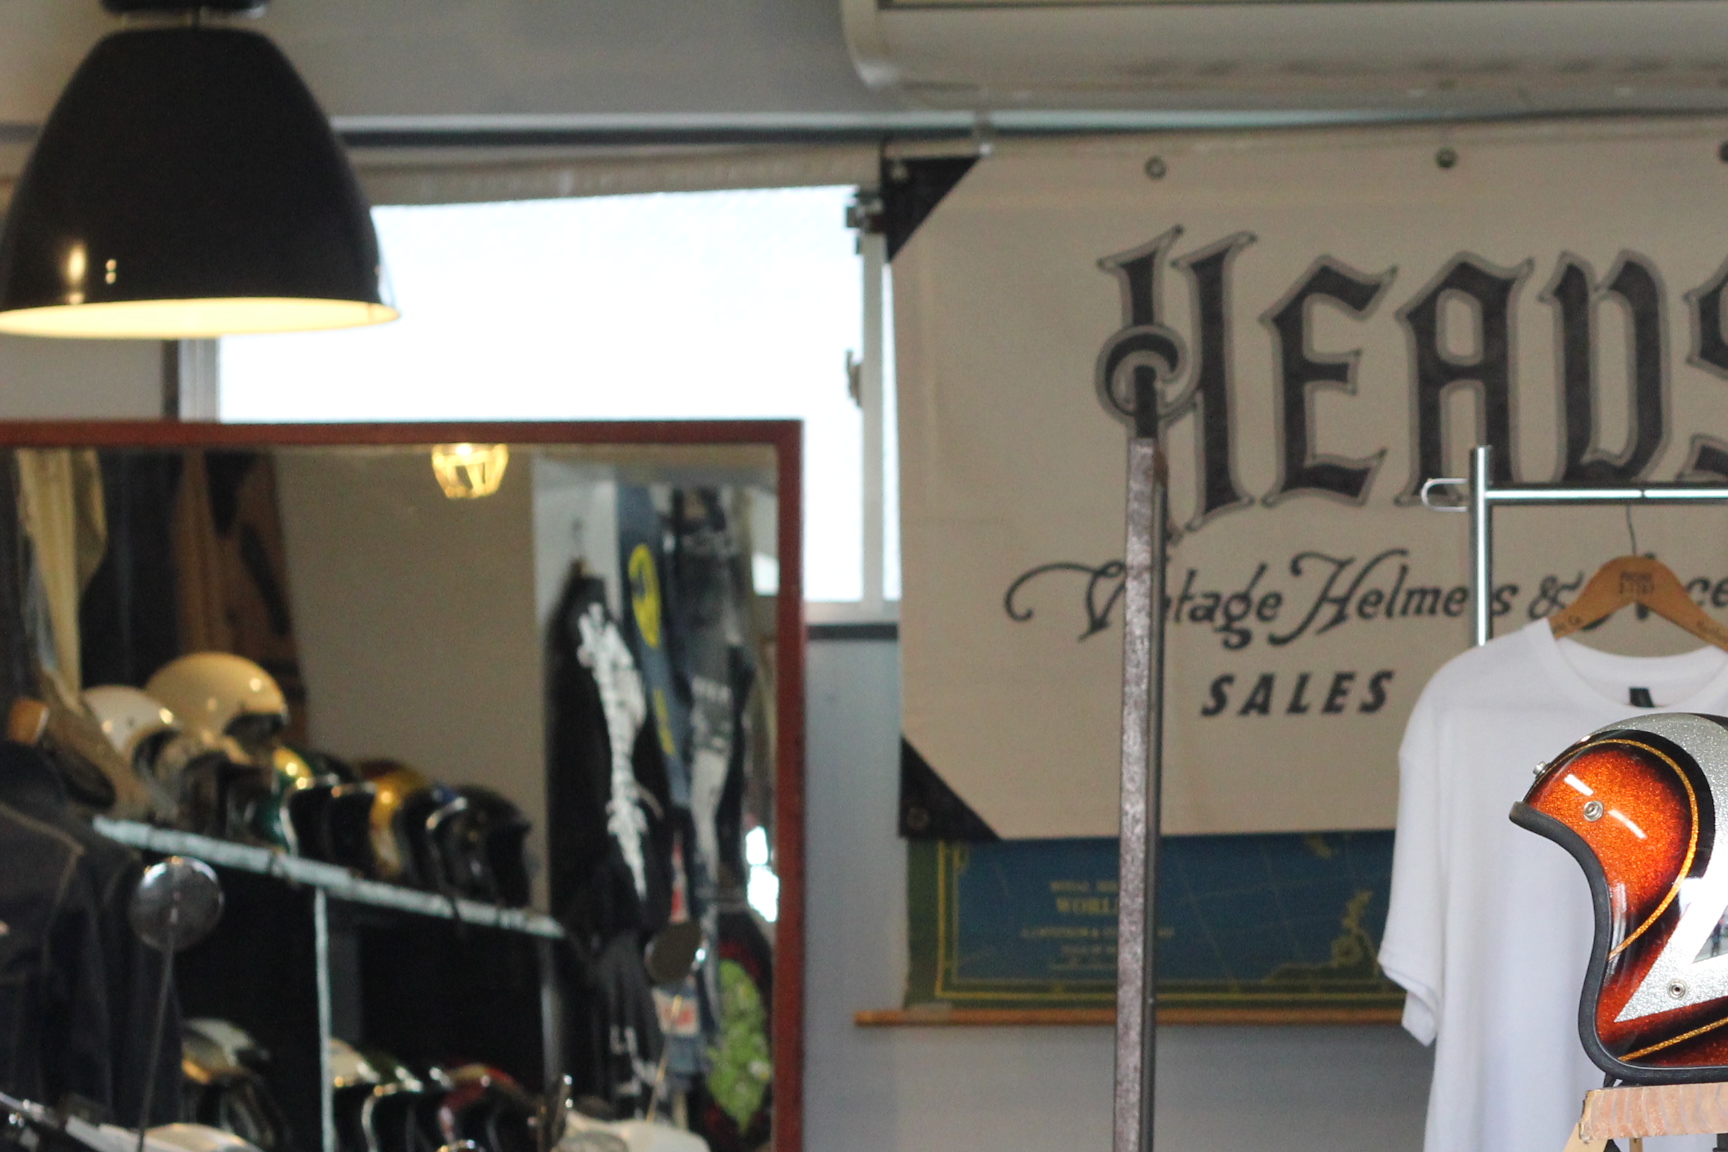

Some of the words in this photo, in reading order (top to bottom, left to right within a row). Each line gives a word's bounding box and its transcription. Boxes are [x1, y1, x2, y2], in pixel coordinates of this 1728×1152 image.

[1003, 558, 1282, 649] Vtage
[1267, 548, 1519, 646] Helmes
[1201, 670, 1395, 717] SALES
